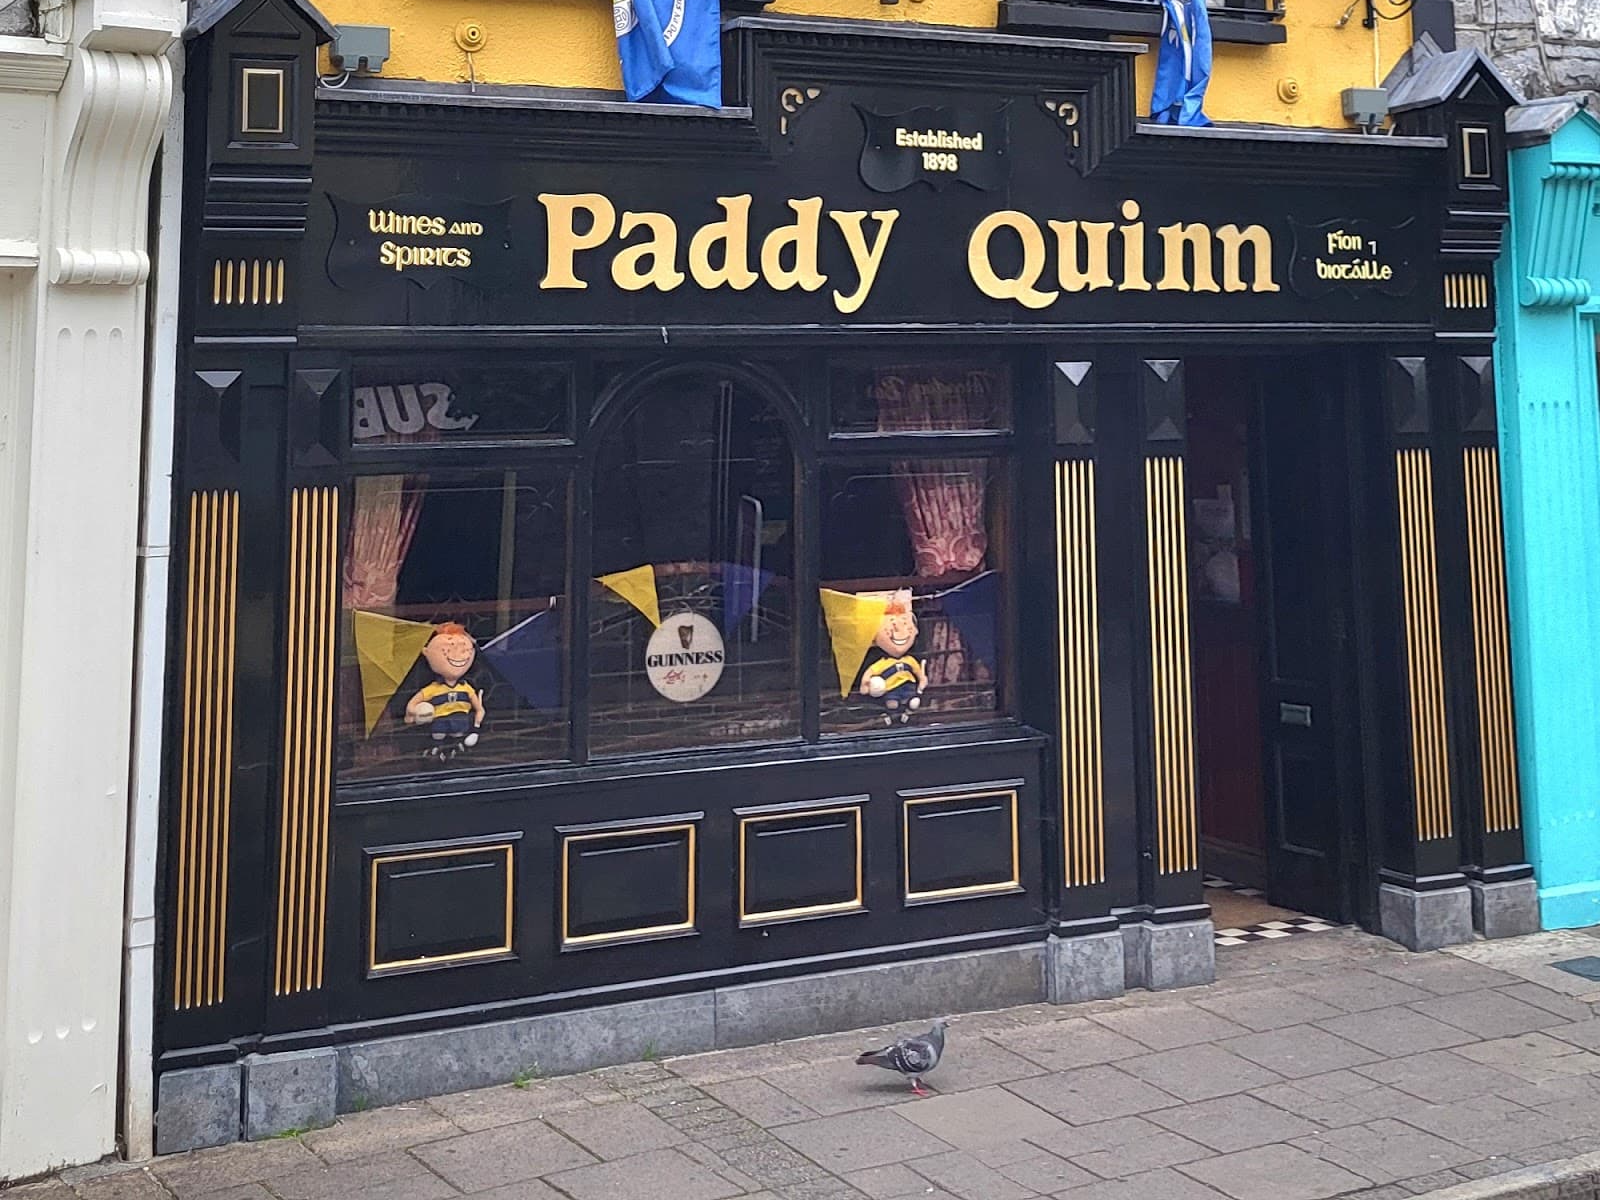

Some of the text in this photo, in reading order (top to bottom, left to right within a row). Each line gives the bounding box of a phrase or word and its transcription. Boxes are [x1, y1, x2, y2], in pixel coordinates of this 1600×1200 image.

[895, 127, 984, 151] Established
[921, 152, 959, 172] 1898
[367, 208, 447, 236] Wines
[538, 192, 1281, 314] Paddy Quinn
[647, 649, 723, 668] GUINNESS
